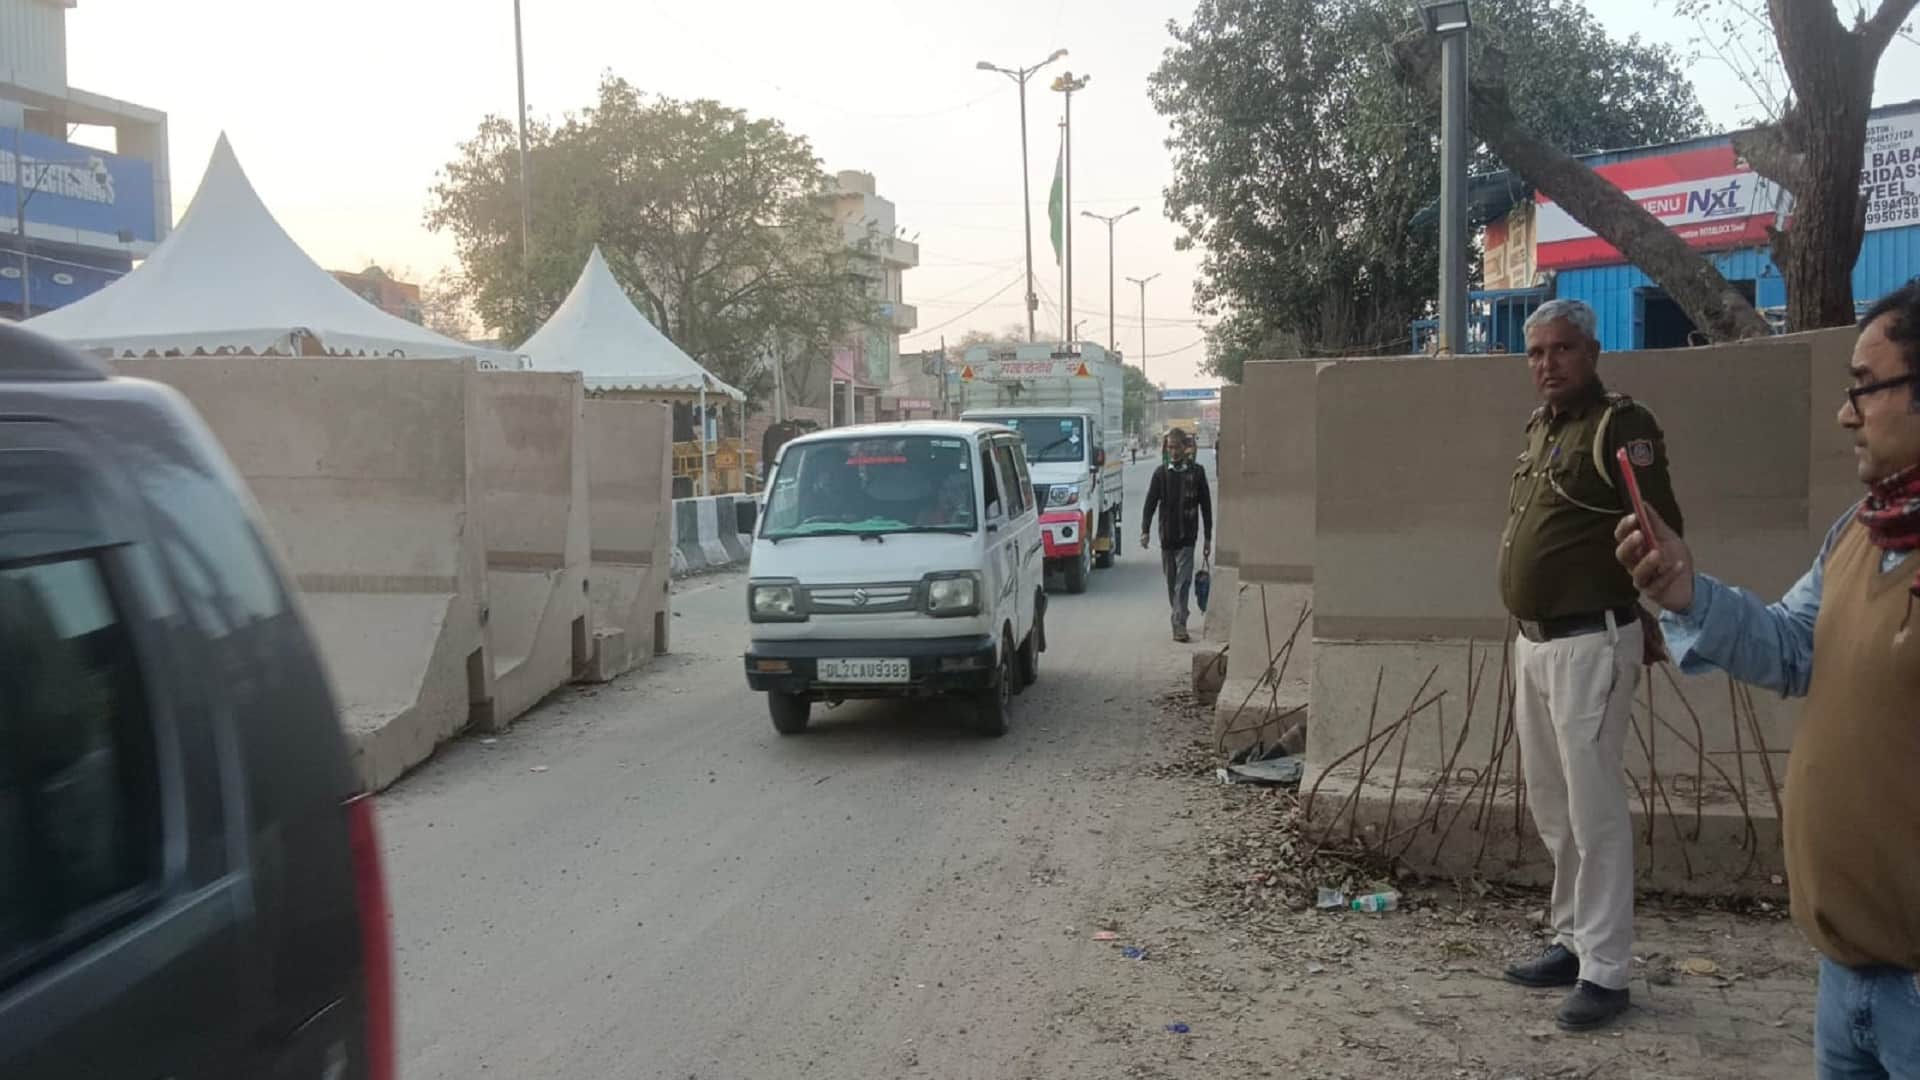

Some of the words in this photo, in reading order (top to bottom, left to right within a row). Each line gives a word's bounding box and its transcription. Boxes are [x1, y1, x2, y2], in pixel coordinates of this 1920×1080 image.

[1873, 146, 1920, 168] BABA
[1687, 179, 1741, 218] Nxt
[826, 663, 908, 678] DL2CAU9383
